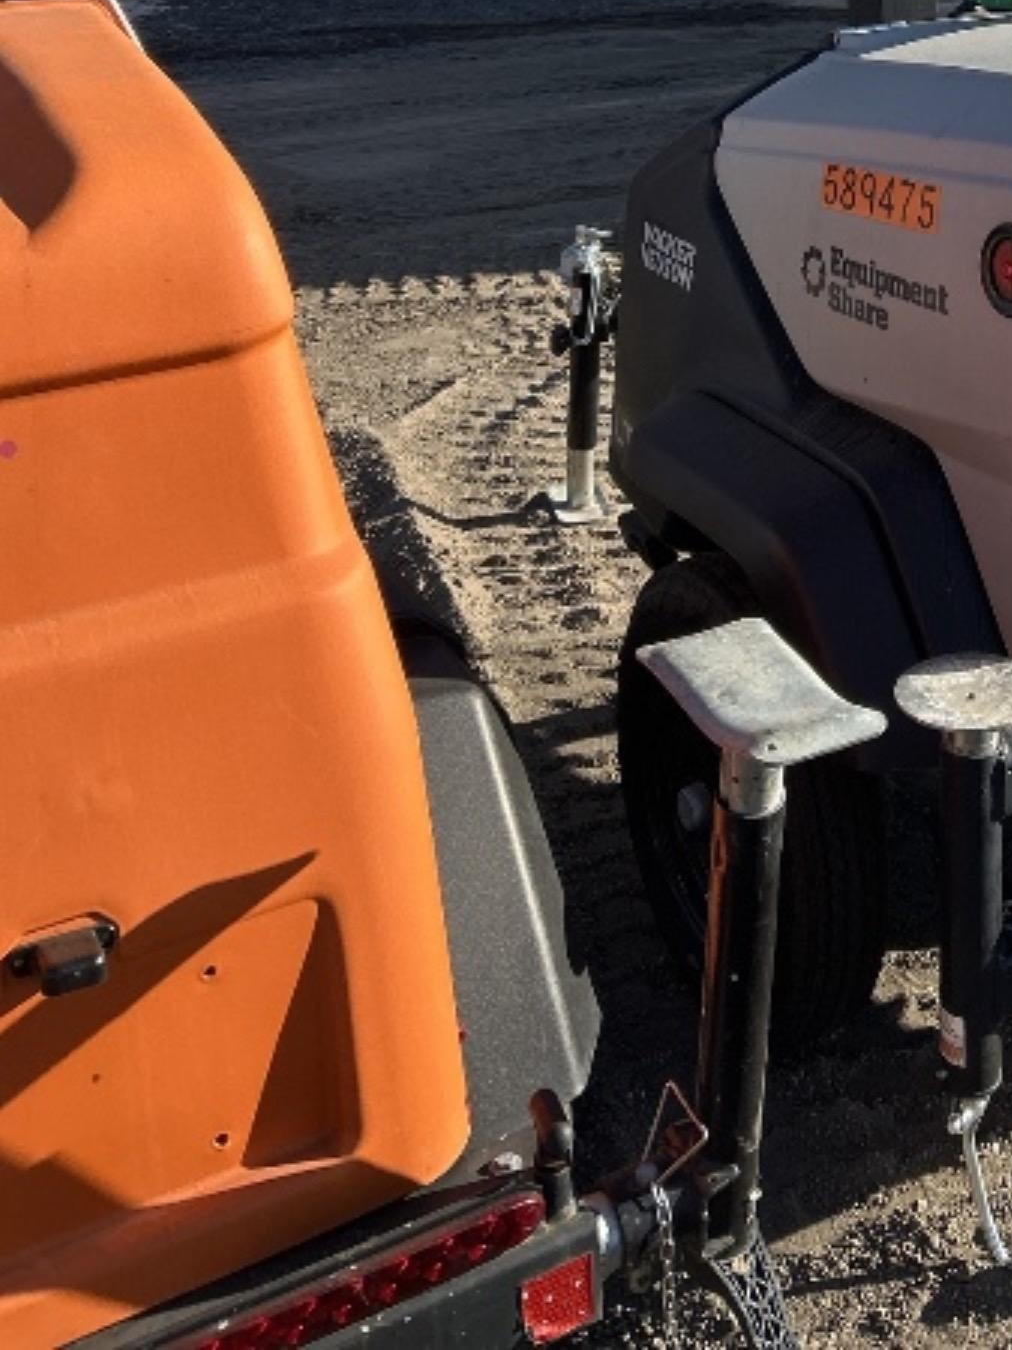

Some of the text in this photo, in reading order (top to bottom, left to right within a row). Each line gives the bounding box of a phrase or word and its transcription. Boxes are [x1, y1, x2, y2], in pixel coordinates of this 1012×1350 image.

[823, 164, 937, 229] 589475
[828, 282, 889, 330] Share
[830, 246, 949, 315] Equipment
